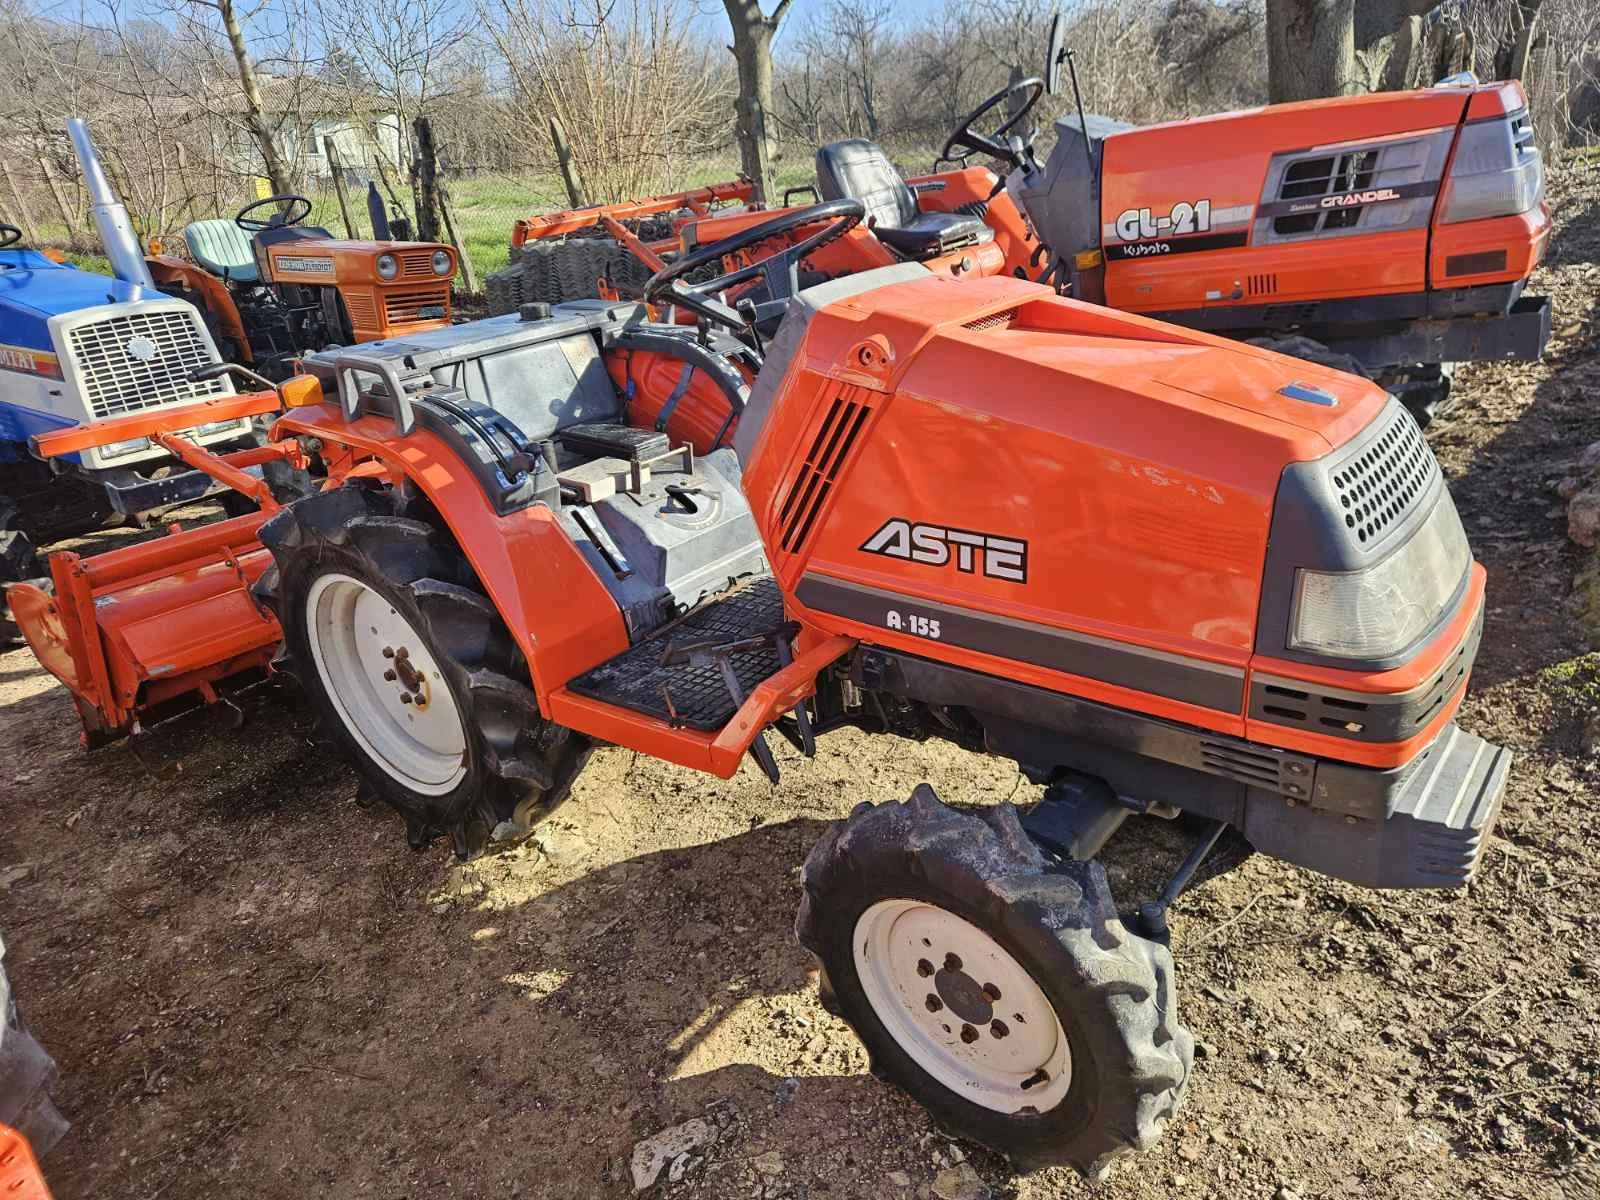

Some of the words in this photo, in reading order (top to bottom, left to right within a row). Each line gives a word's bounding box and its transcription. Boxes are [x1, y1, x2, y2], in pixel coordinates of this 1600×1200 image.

[1321, 189, 1400, 208] GRANDEL
[1115, 198, 1211, 241] GL-21
[1123, 242, 1171, 256] Kubota
[857, 517, 1028, 584] ASTE
